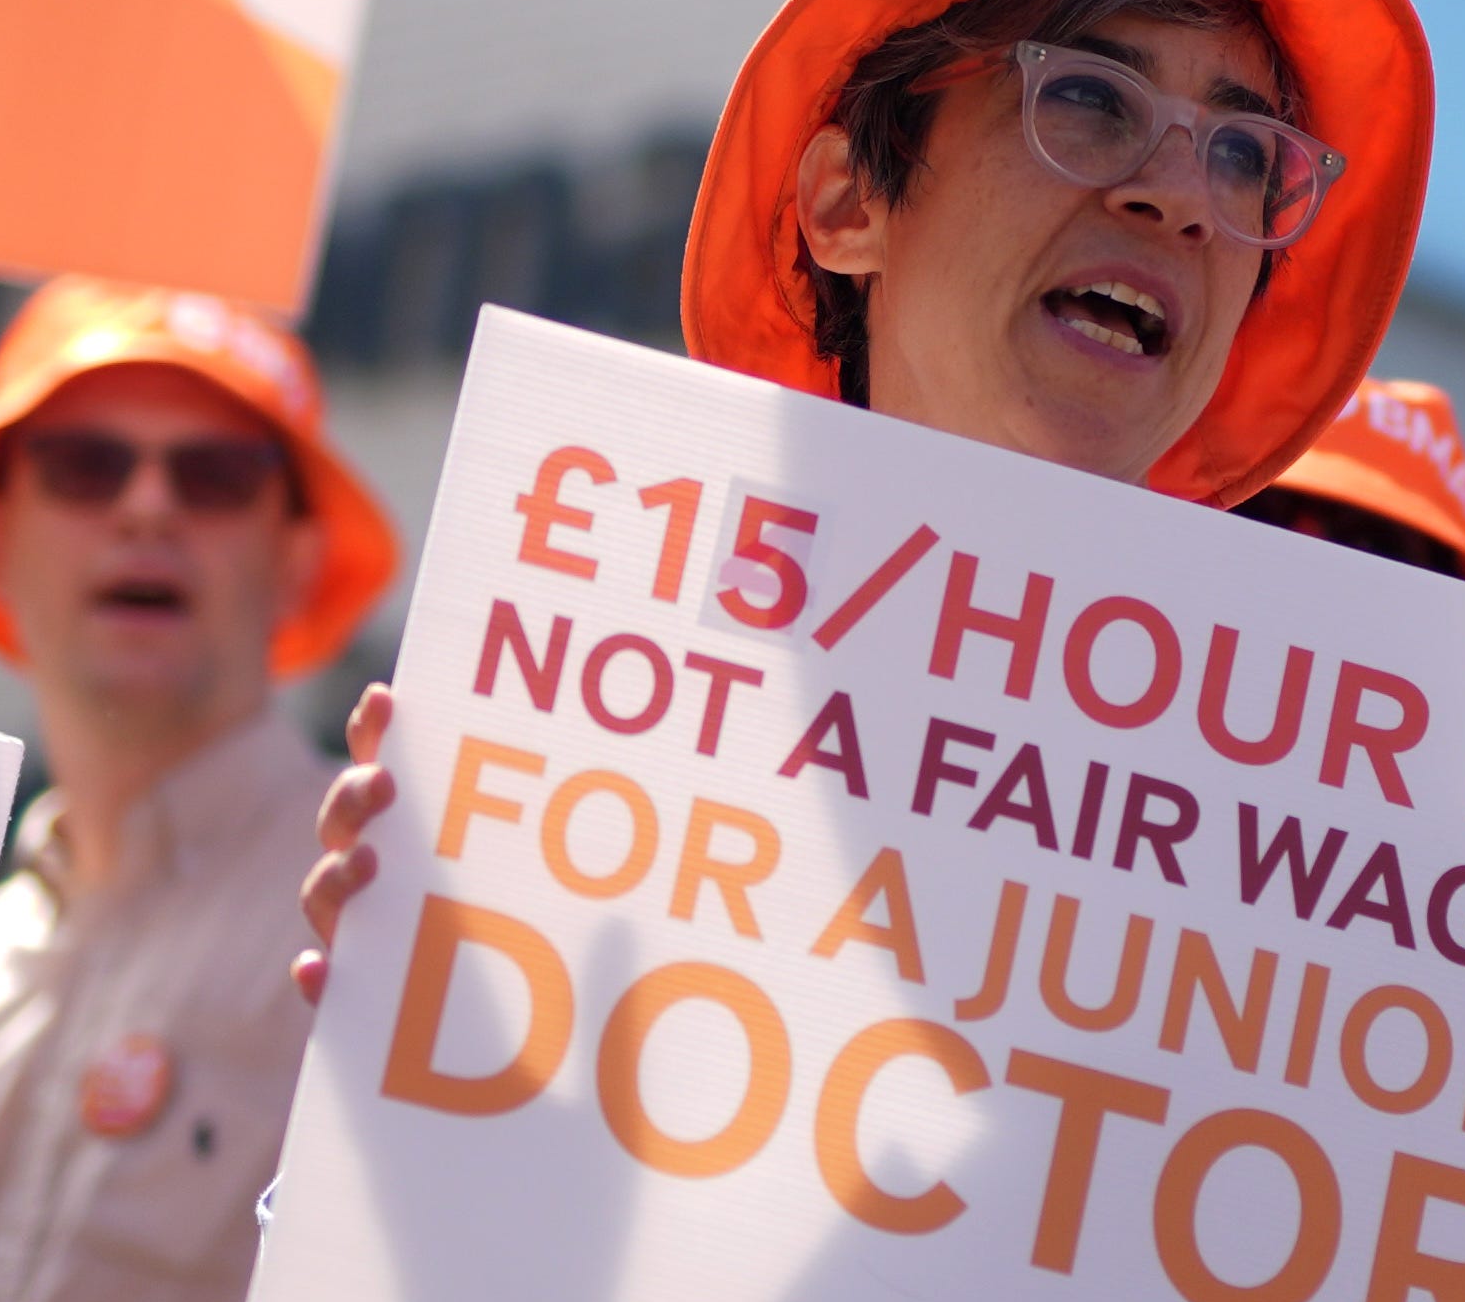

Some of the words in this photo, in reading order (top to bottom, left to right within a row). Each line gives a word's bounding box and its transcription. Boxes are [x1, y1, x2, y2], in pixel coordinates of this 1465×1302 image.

[471, 599, 766, 757] NOT
[777, 690, 872, 798] A
[910, 715, 1203, 888] FAIR
[511, 444, 1432, 811] £15/HOUR
[435, 734, 784, 940] FOR
[809, 847, 926, 986] A
